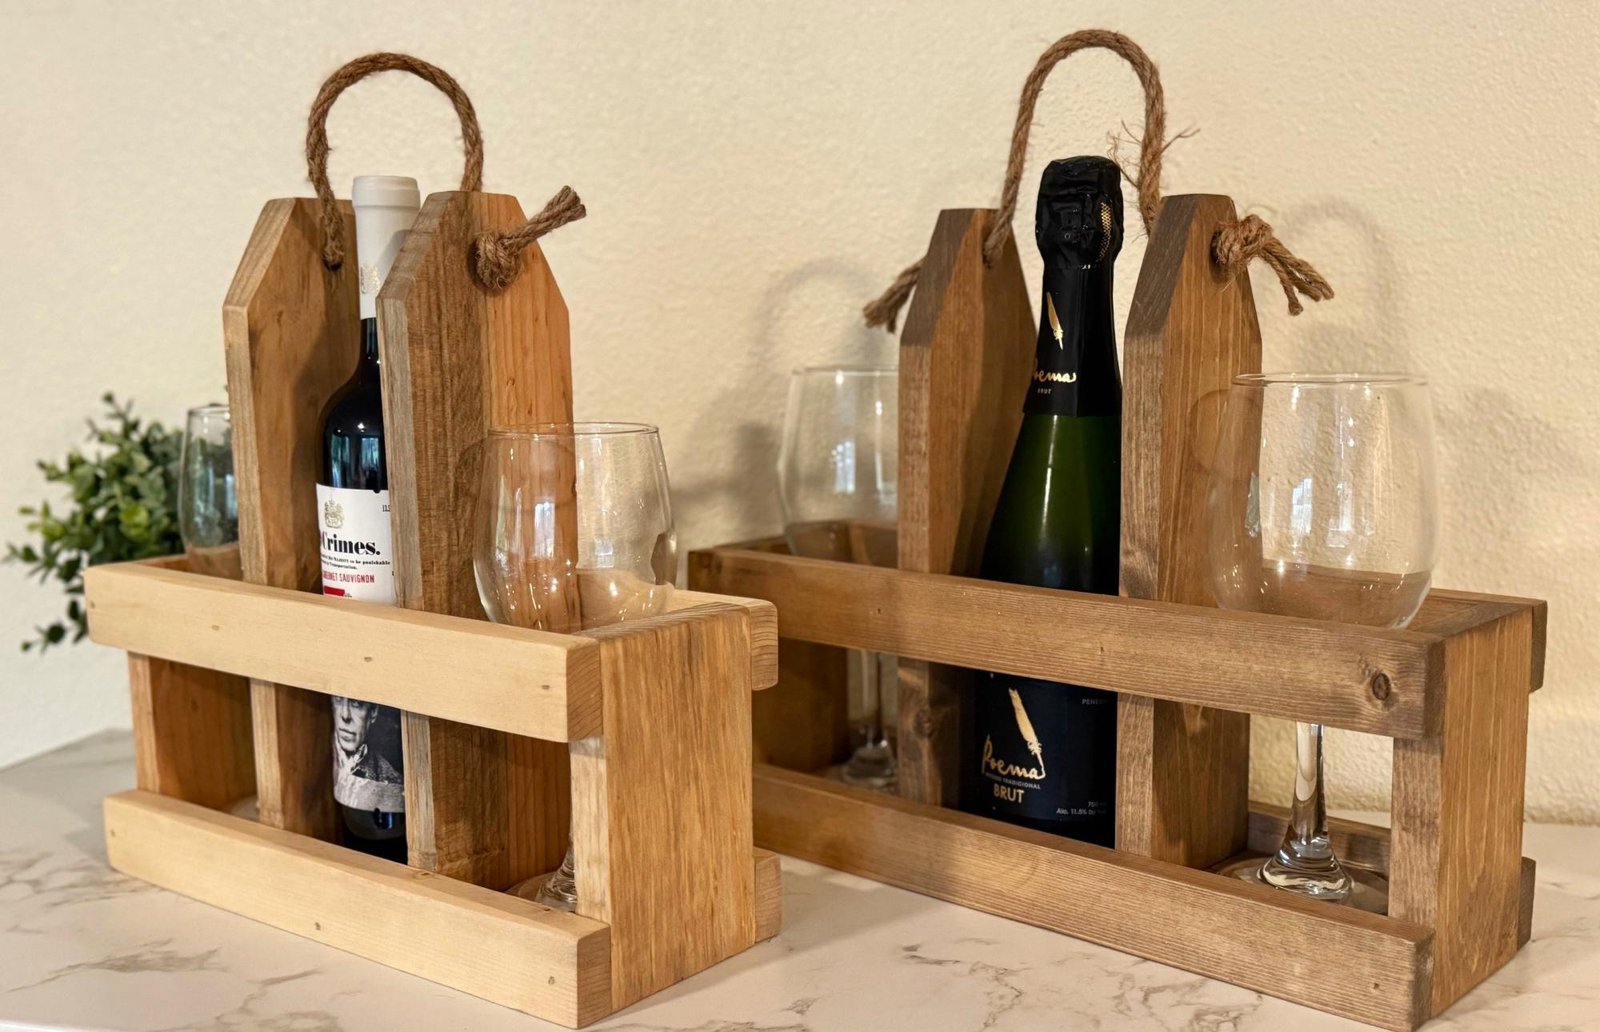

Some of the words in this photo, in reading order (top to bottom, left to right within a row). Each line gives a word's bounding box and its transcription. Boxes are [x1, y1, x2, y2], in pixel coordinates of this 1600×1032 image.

[1032, 370, 1077, 383] oema
[321, 530, 381, 556] Crimes.
[339, 573, 375, 583] SAUVIGNON
[982, 734, 1046, 780] Poema
[993, 783, 1025, 803] BRUT
